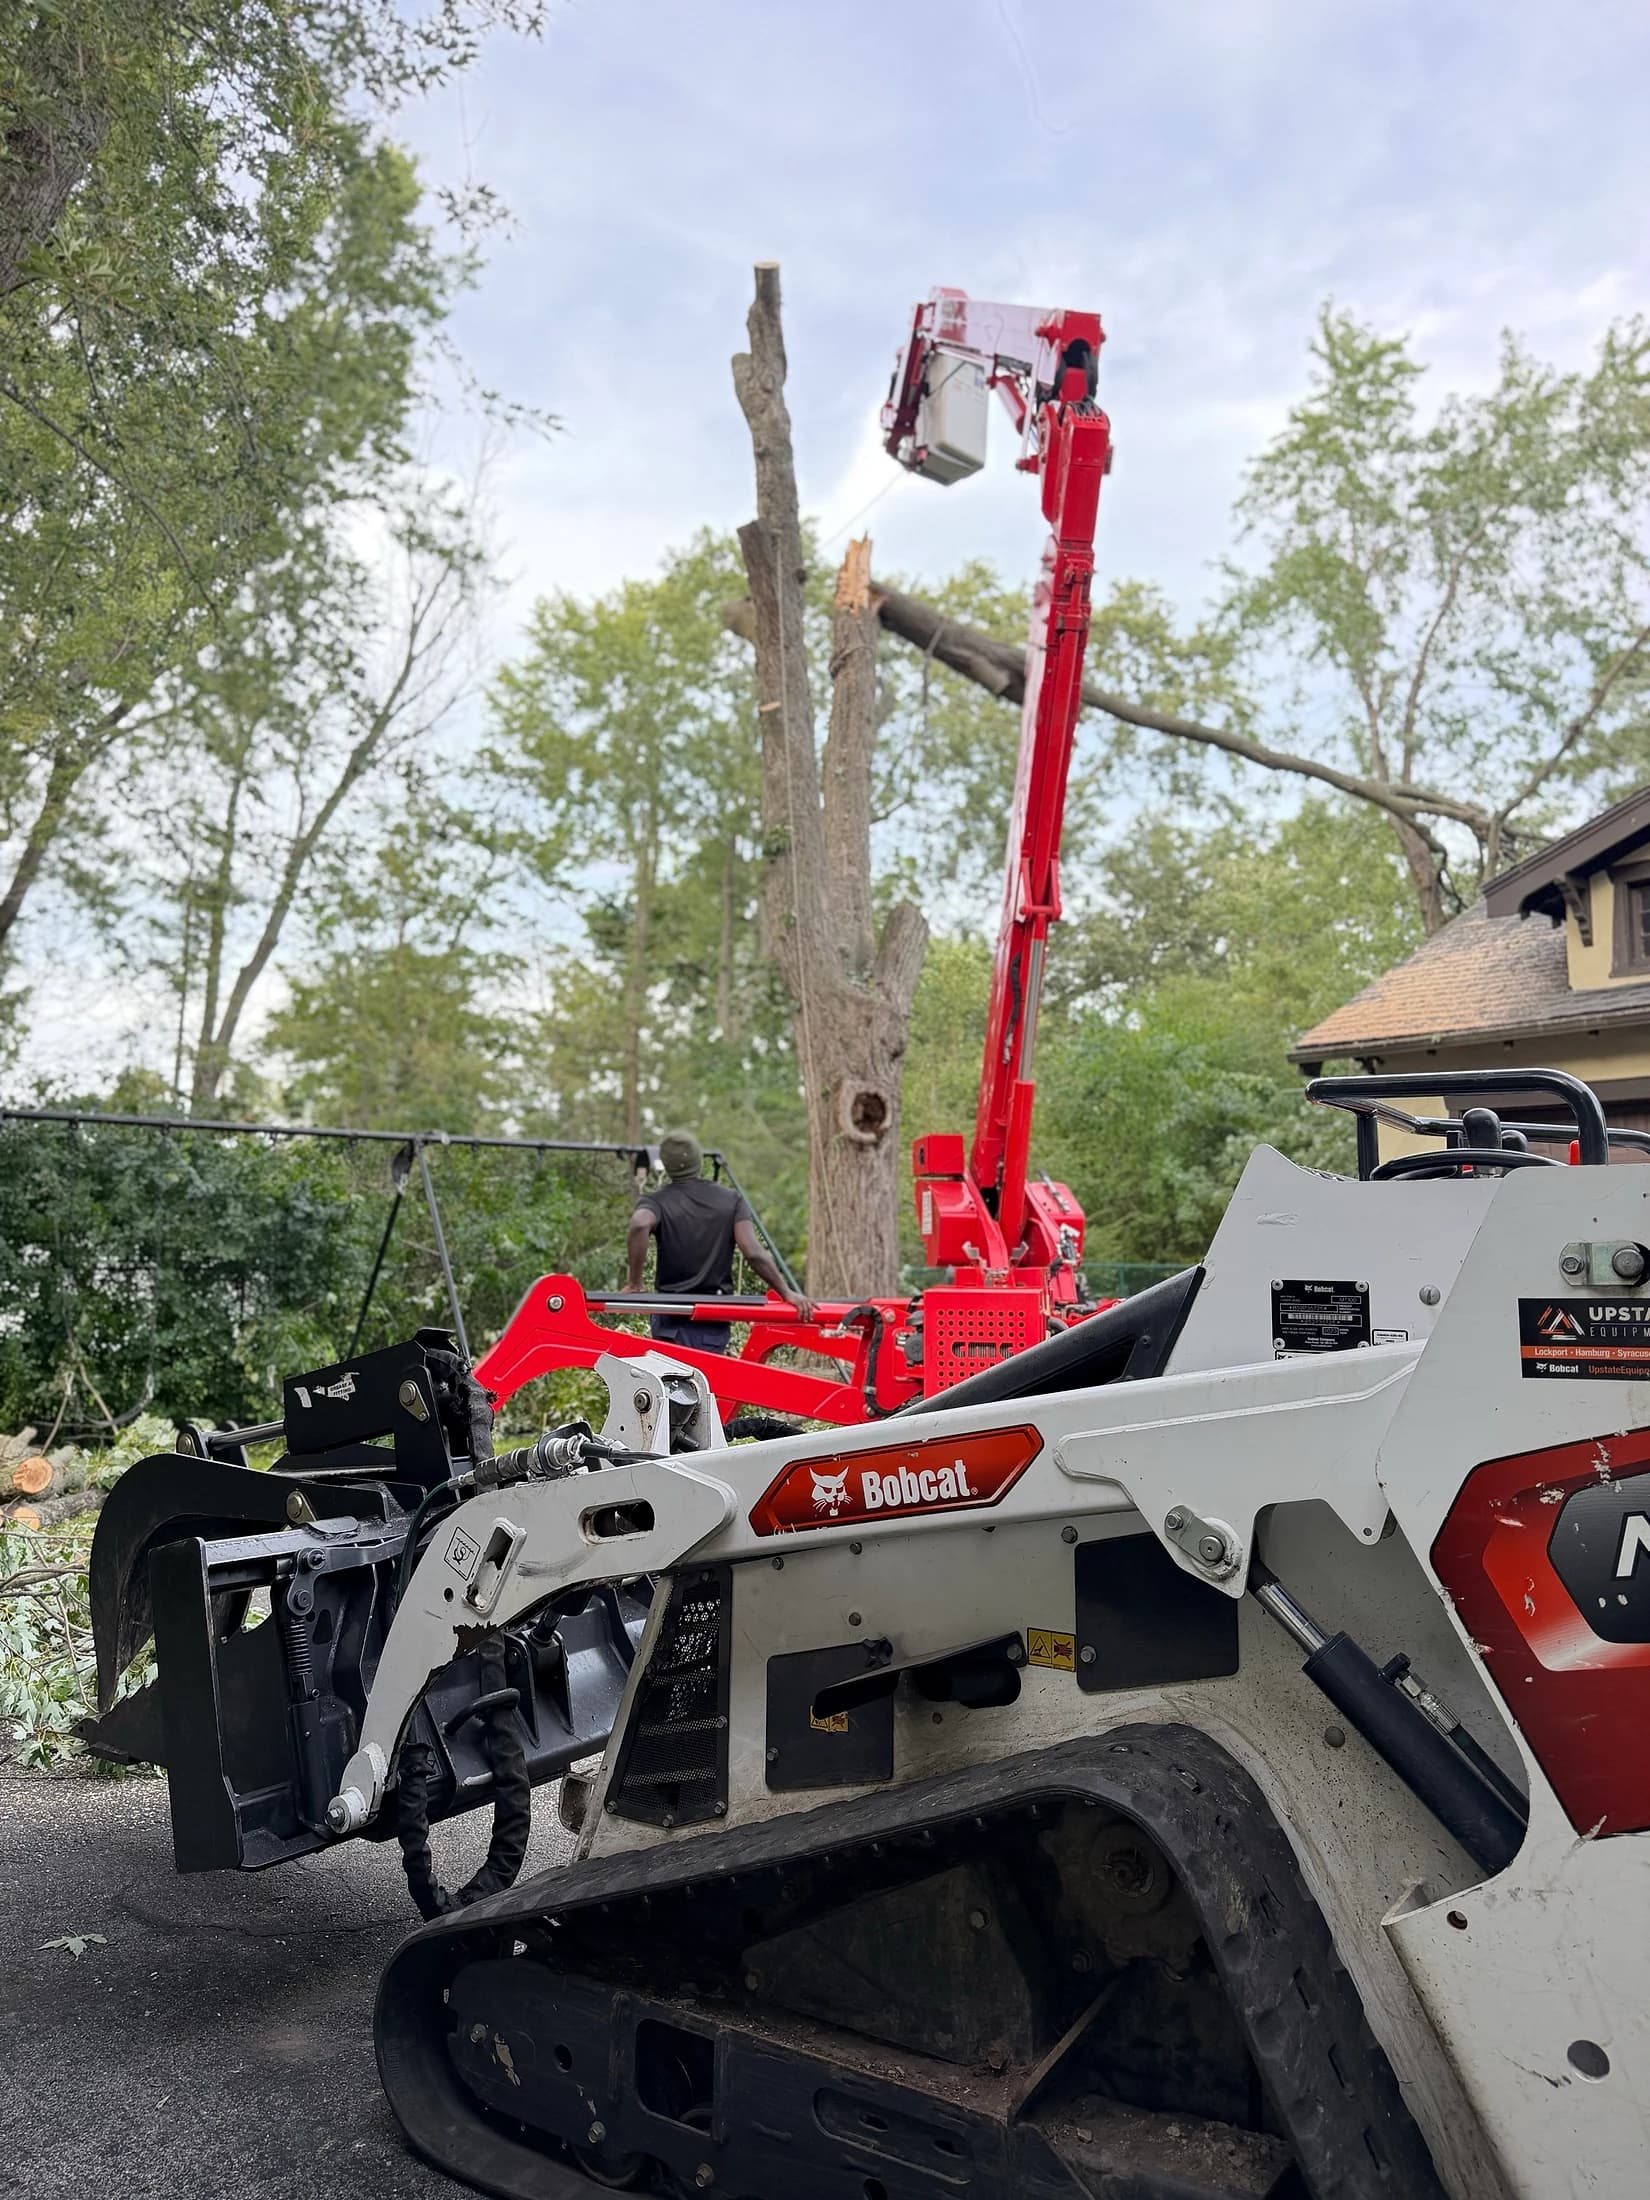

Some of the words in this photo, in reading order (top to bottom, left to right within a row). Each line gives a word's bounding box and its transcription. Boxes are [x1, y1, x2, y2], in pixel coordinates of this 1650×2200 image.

[1535, 1348, 1568, 1358] Lockport
[1575, 1349, 1610, 1358] Hamburg
[1549, 1364, 1579, 1373] Bobcat
[861, 1459, 971, 1510] Bobcat
